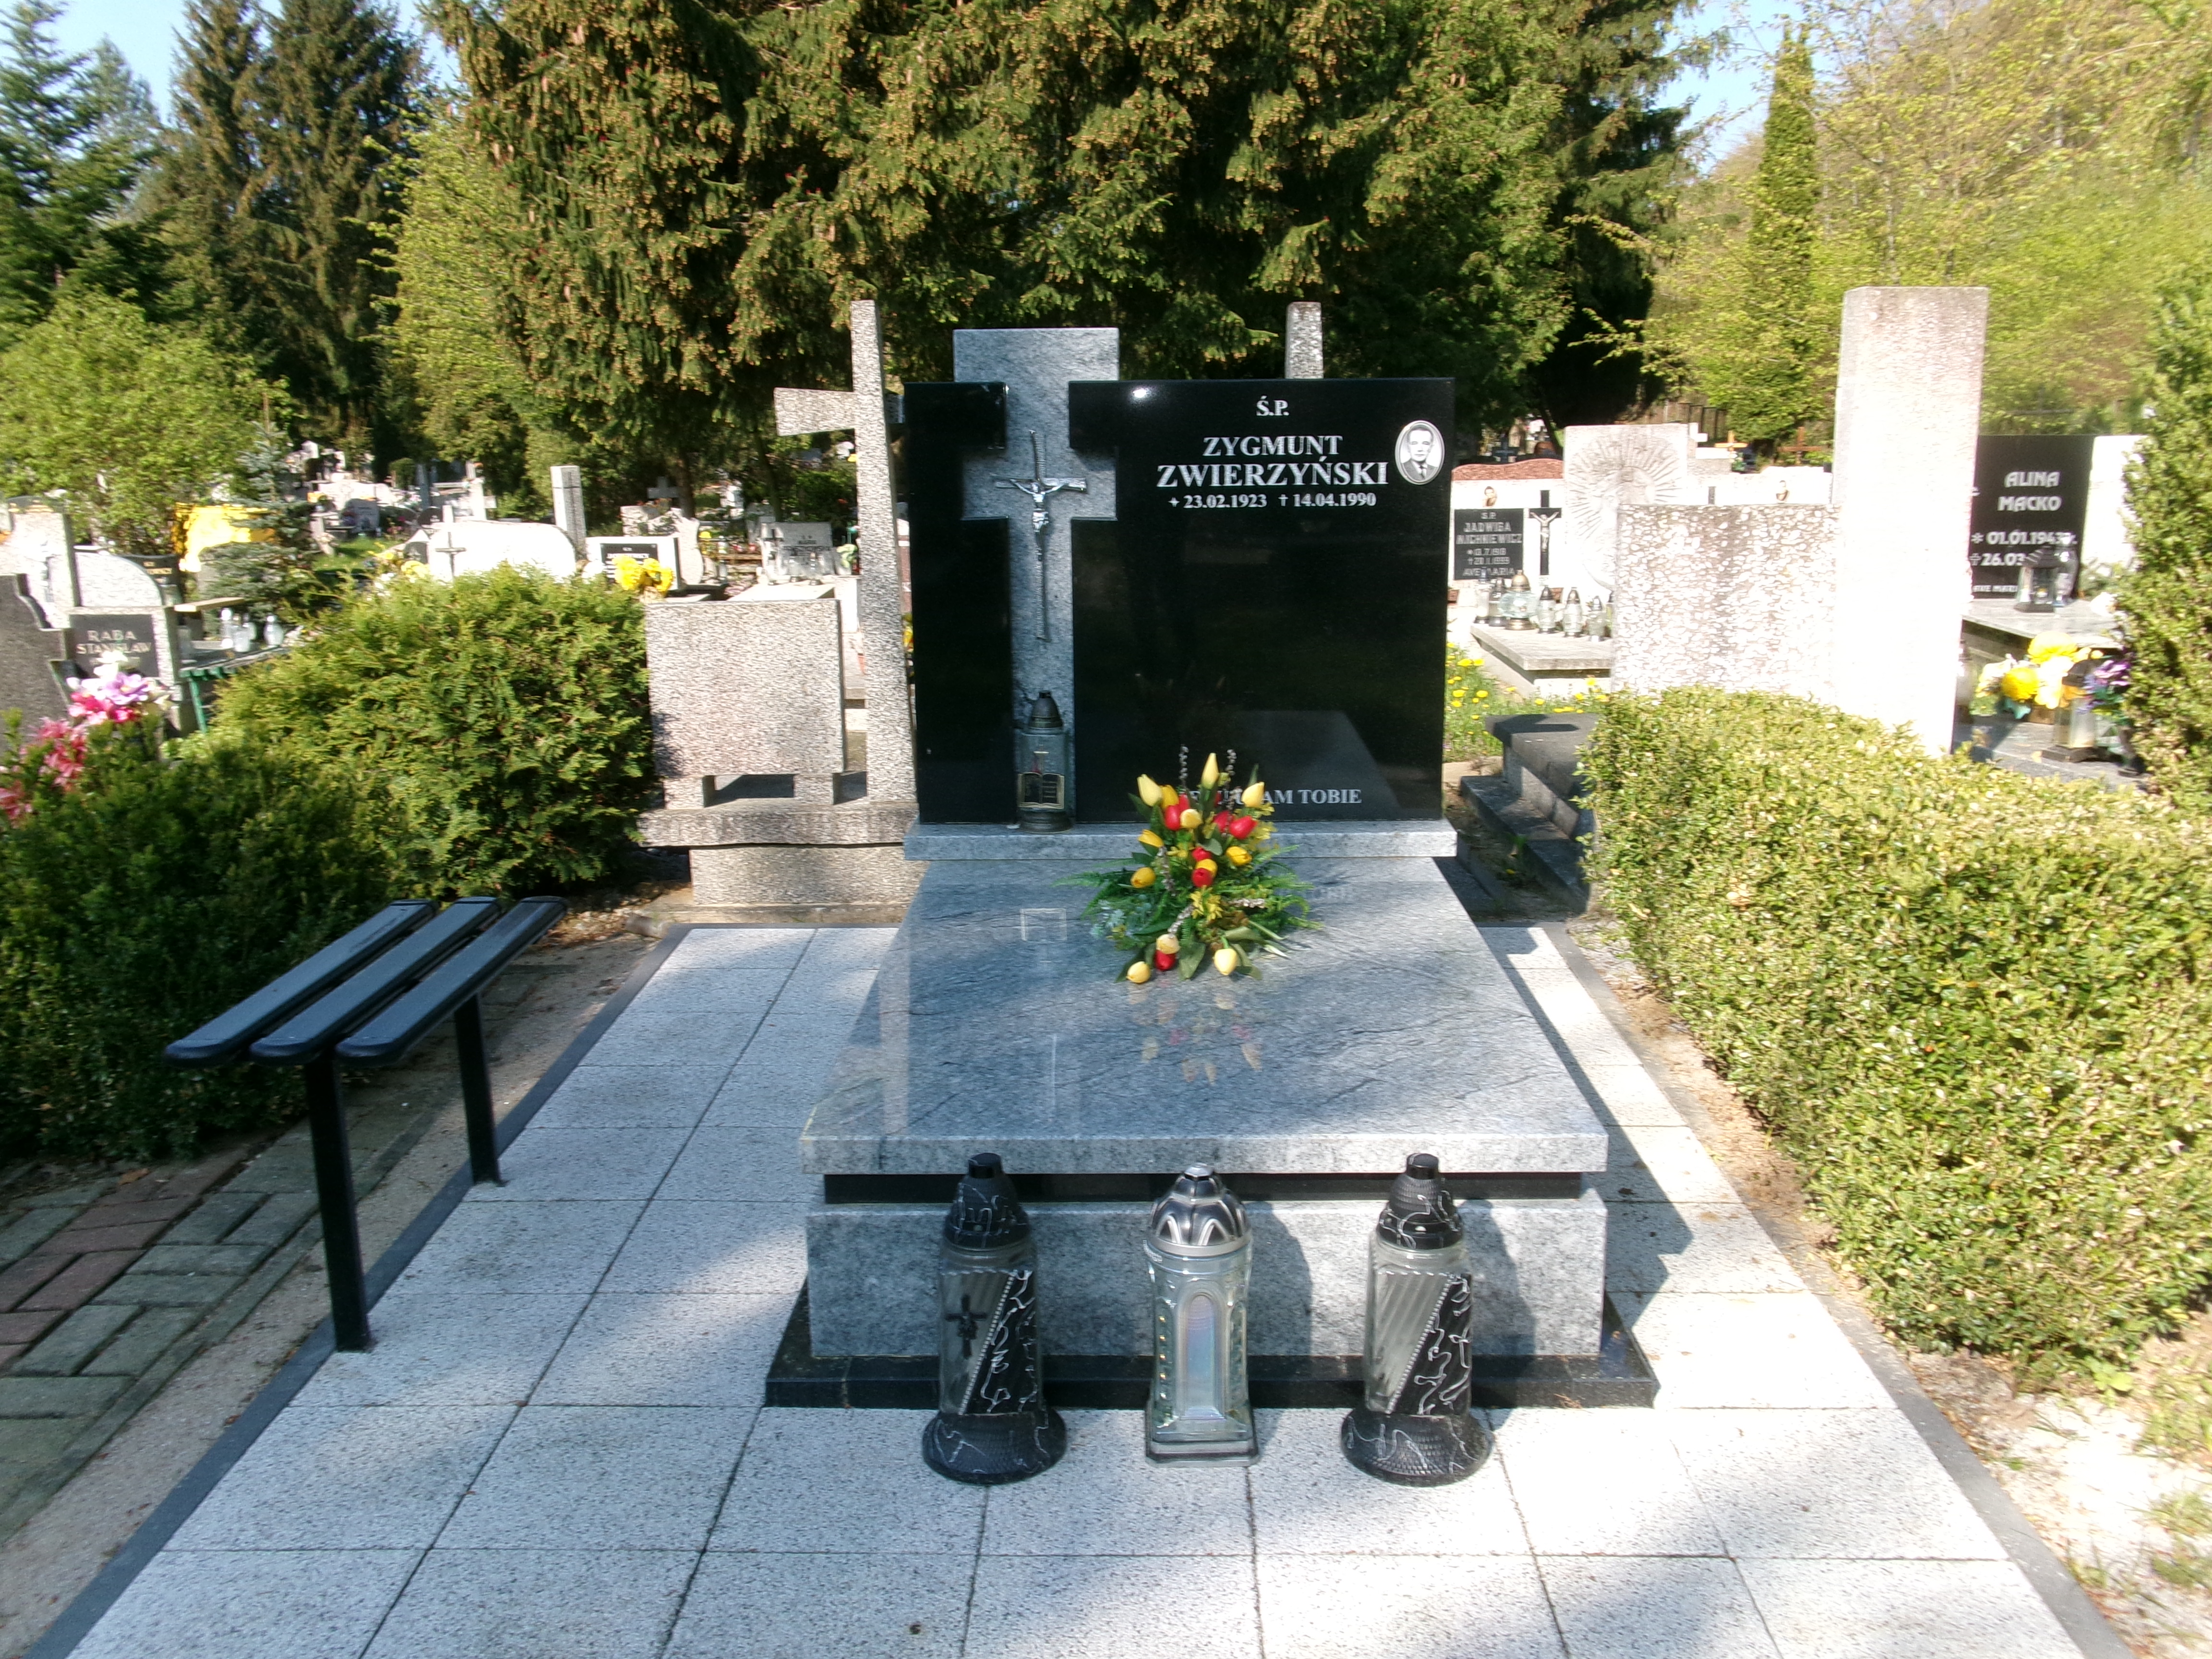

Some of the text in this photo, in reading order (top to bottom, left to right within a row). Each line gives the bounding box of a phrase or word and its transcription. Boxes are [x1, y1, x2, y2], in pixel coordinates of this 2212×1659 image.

[1256, 395, 1289, 416] Ś.P.
[1202, 435, 1343, 456] ZYGMUNT
[1156, 456, 1389, 487] ZWIERZYŃSKI
[2004, 471, 2060, 488] ALINA
[1183, 493, 1376, 508] 23.02.1923 14.04.1990
[1997, 496, 2062, 512] MACKO
[1464, 522, 1512, 532] JADWIGA
[87, 630, 137, 642] RABA
[1298, 789, 1362, 804] TOBIE
